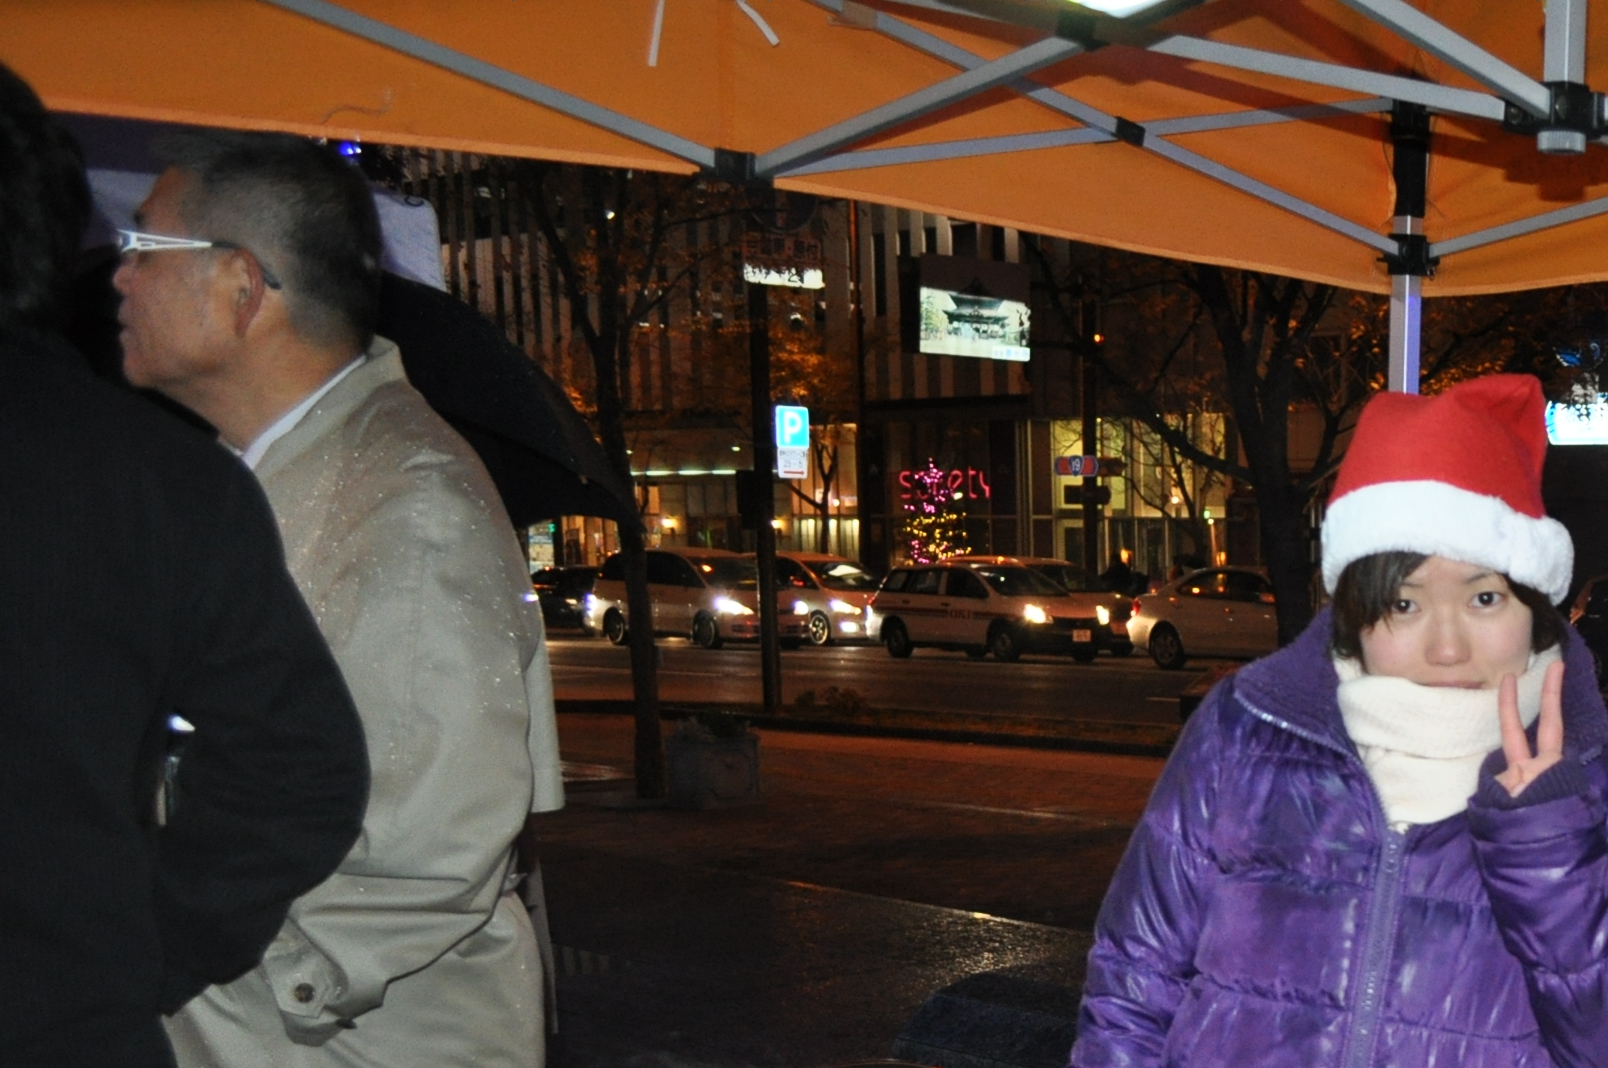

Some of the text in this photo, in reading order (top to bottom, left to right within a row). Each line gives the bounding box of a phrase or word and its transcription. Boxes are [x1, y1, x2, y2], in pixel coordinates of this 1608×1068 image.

[783, 410, 803, 444] P
[899, 465, 991, 499] sety
[1070, 459, 1081, 472] 19
